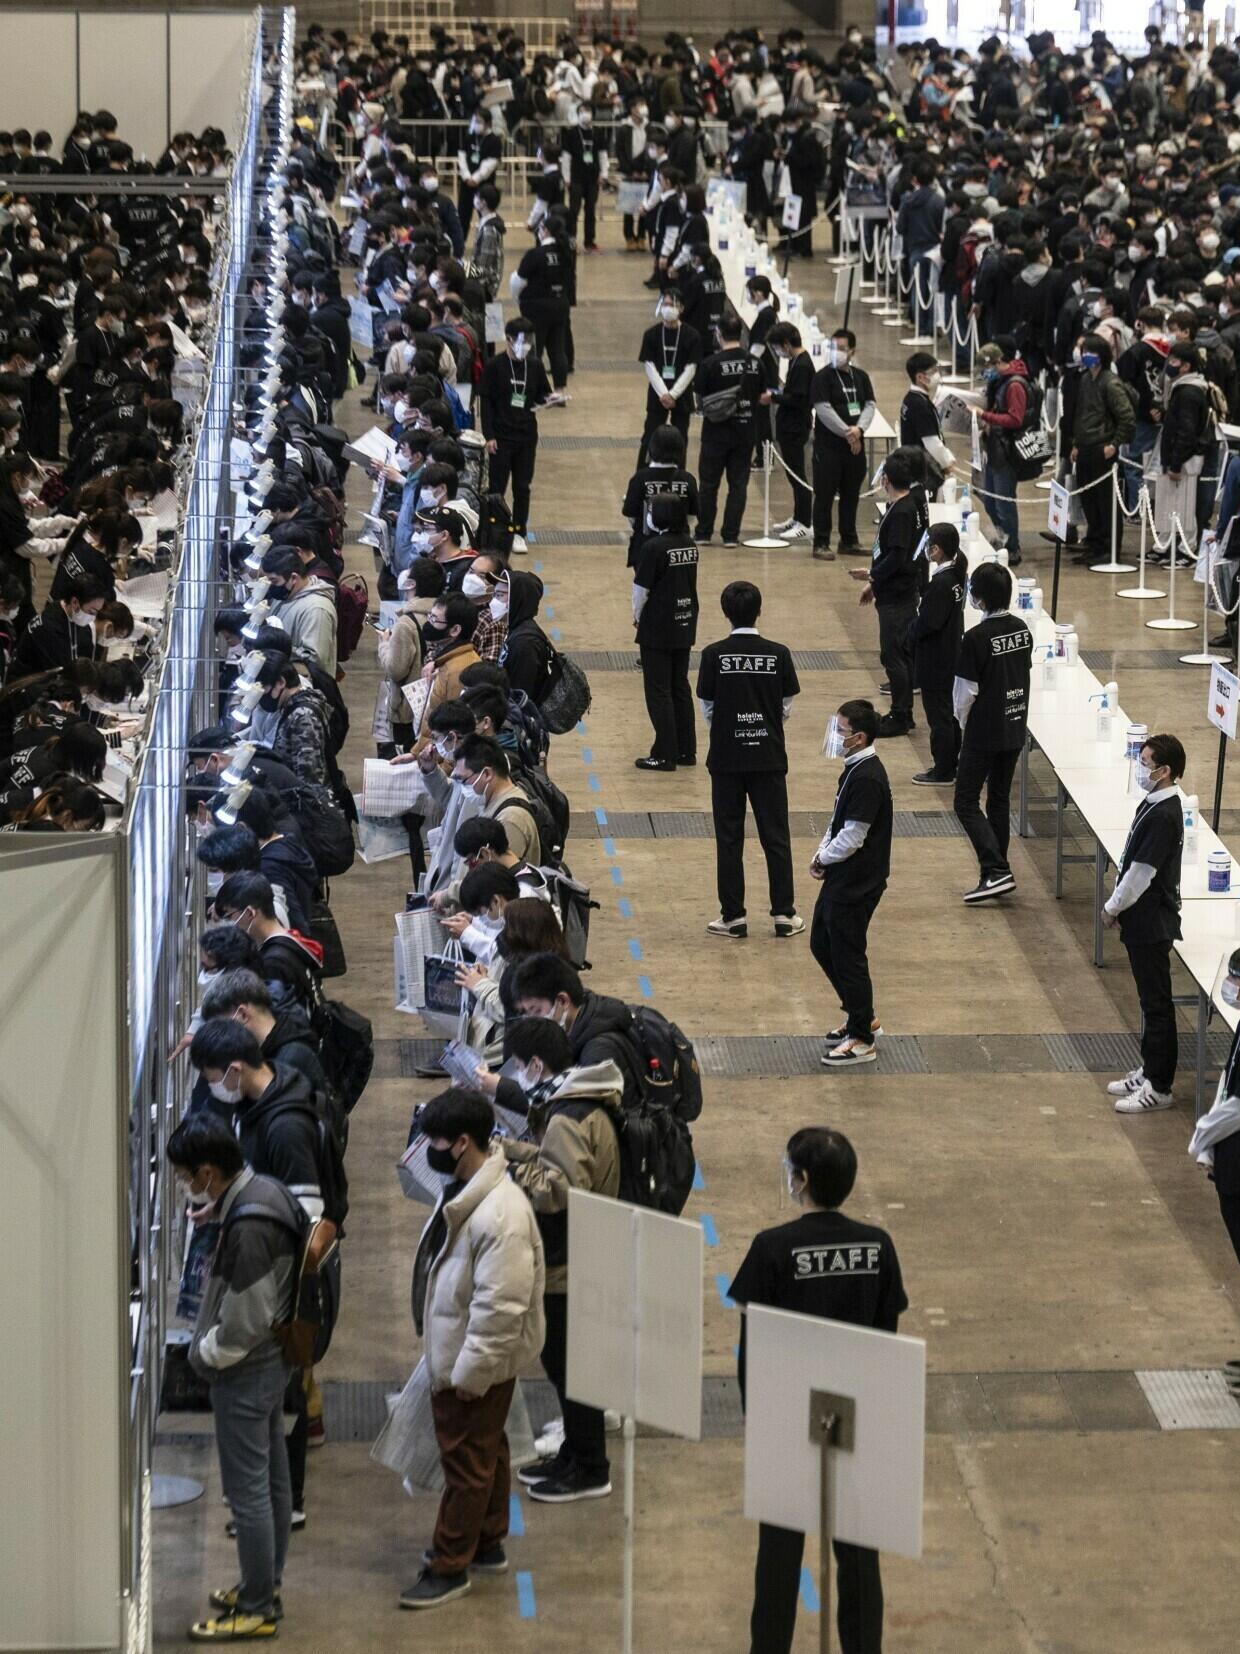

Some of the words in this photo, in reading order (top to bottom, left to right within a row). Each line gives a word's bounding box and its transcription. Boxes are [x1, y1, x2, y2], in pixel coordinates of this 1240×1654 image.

[721, 362, 758, 374] STAF
[646, 484, 687, 495] STFF
[670, 550, 697, 563] STAFF
[992, 632, 1030, 653] STAFF
[721, 657, 775, 671] STAFF
[796, 1248, 879, 1273] STAFF
